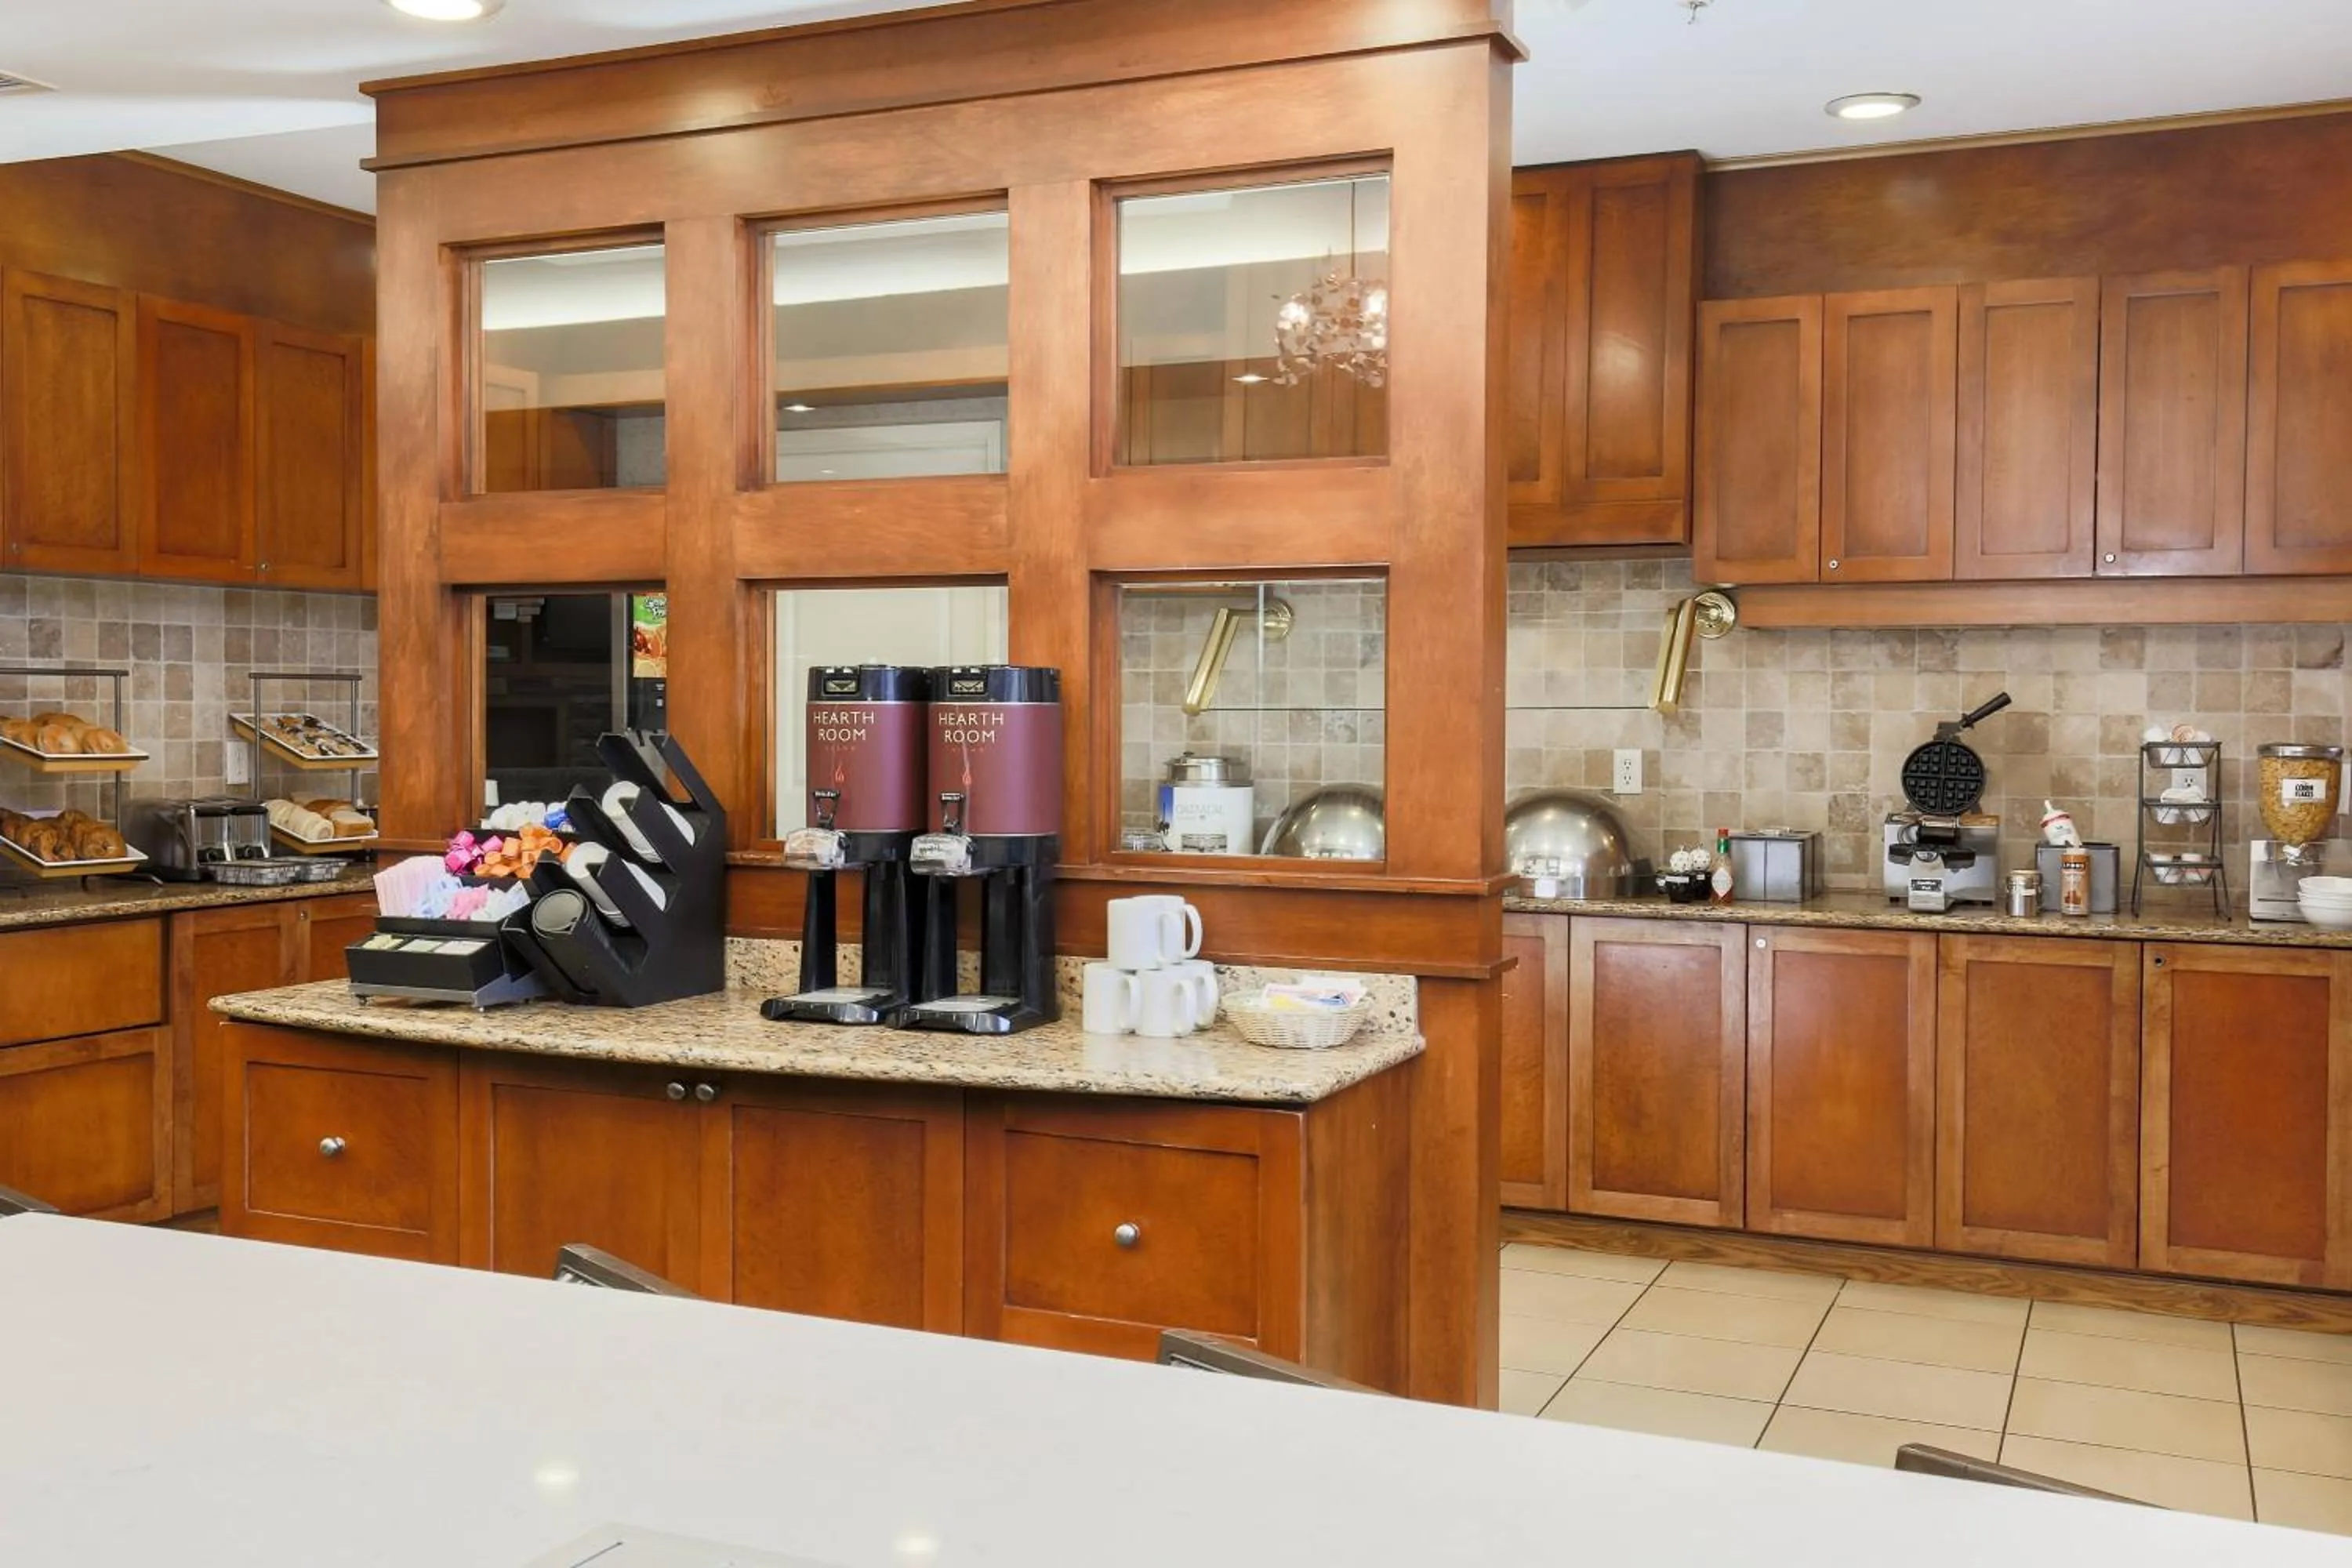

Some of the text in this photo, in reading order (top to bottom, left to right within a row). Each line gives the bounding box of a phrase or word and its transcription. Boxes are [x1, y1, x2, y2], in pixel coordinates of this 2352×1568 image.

[813, 711, 875, 724] HEARTH
[938, 712, 1004, 726] HEARTH
[818, 728, 866, 742] ROOM
[945, 730, 995, 743] ROOM
